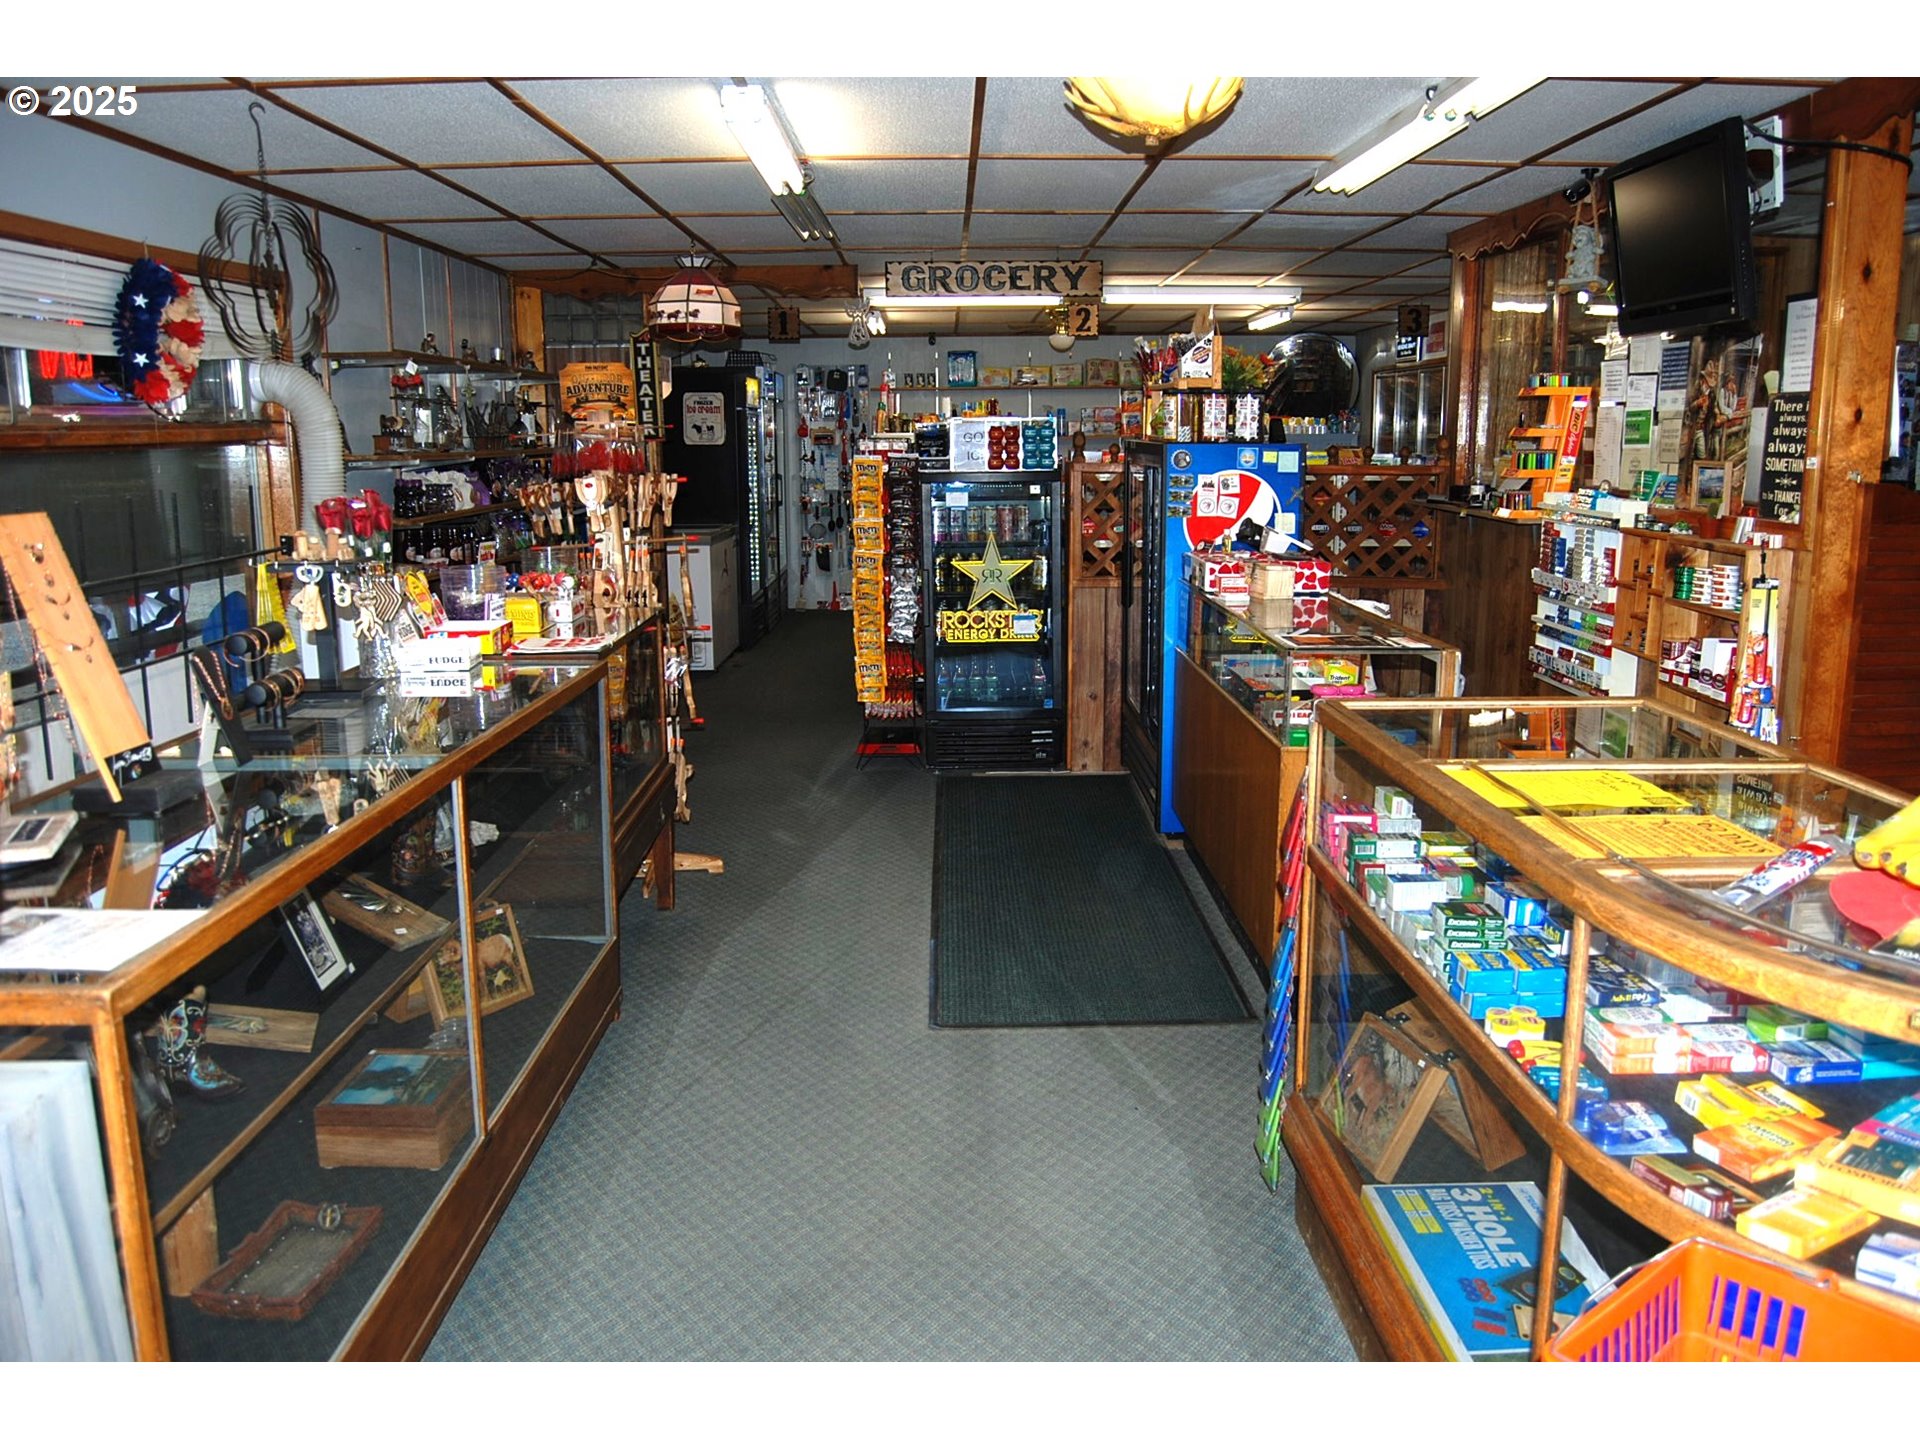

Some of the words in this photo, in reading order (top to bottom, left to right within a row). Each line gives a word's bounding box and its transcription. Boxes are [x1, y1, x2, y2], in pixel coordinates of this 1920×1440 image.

[901, 265, 1088, 293] GROCERY
[777, 311, 788, 335] 1
[1076, 308, 1091, 332] 2
[1408, 308, 1422, 332] 3
[566, 383, 630, 396] ADVENTURE
[634, 343, 656, 436] THEATER
[1774, 400, 1802, 412] There
[963, 432, 984, 443] GO
[967, 451, 984, 461] IC
[1765, 458, 1804, 472] SOMETHIN
[1774, 490, 1801, 504] THANKF
[941, 609, 1043, 629] ROCKSTR
[947, 629, 997, 640] ENERGY
[429, 656, 465, 664] FUDGE
[1450, 1188, 1482, 1202] 3
[1462, 1206, 1532, 1268] HOLE
